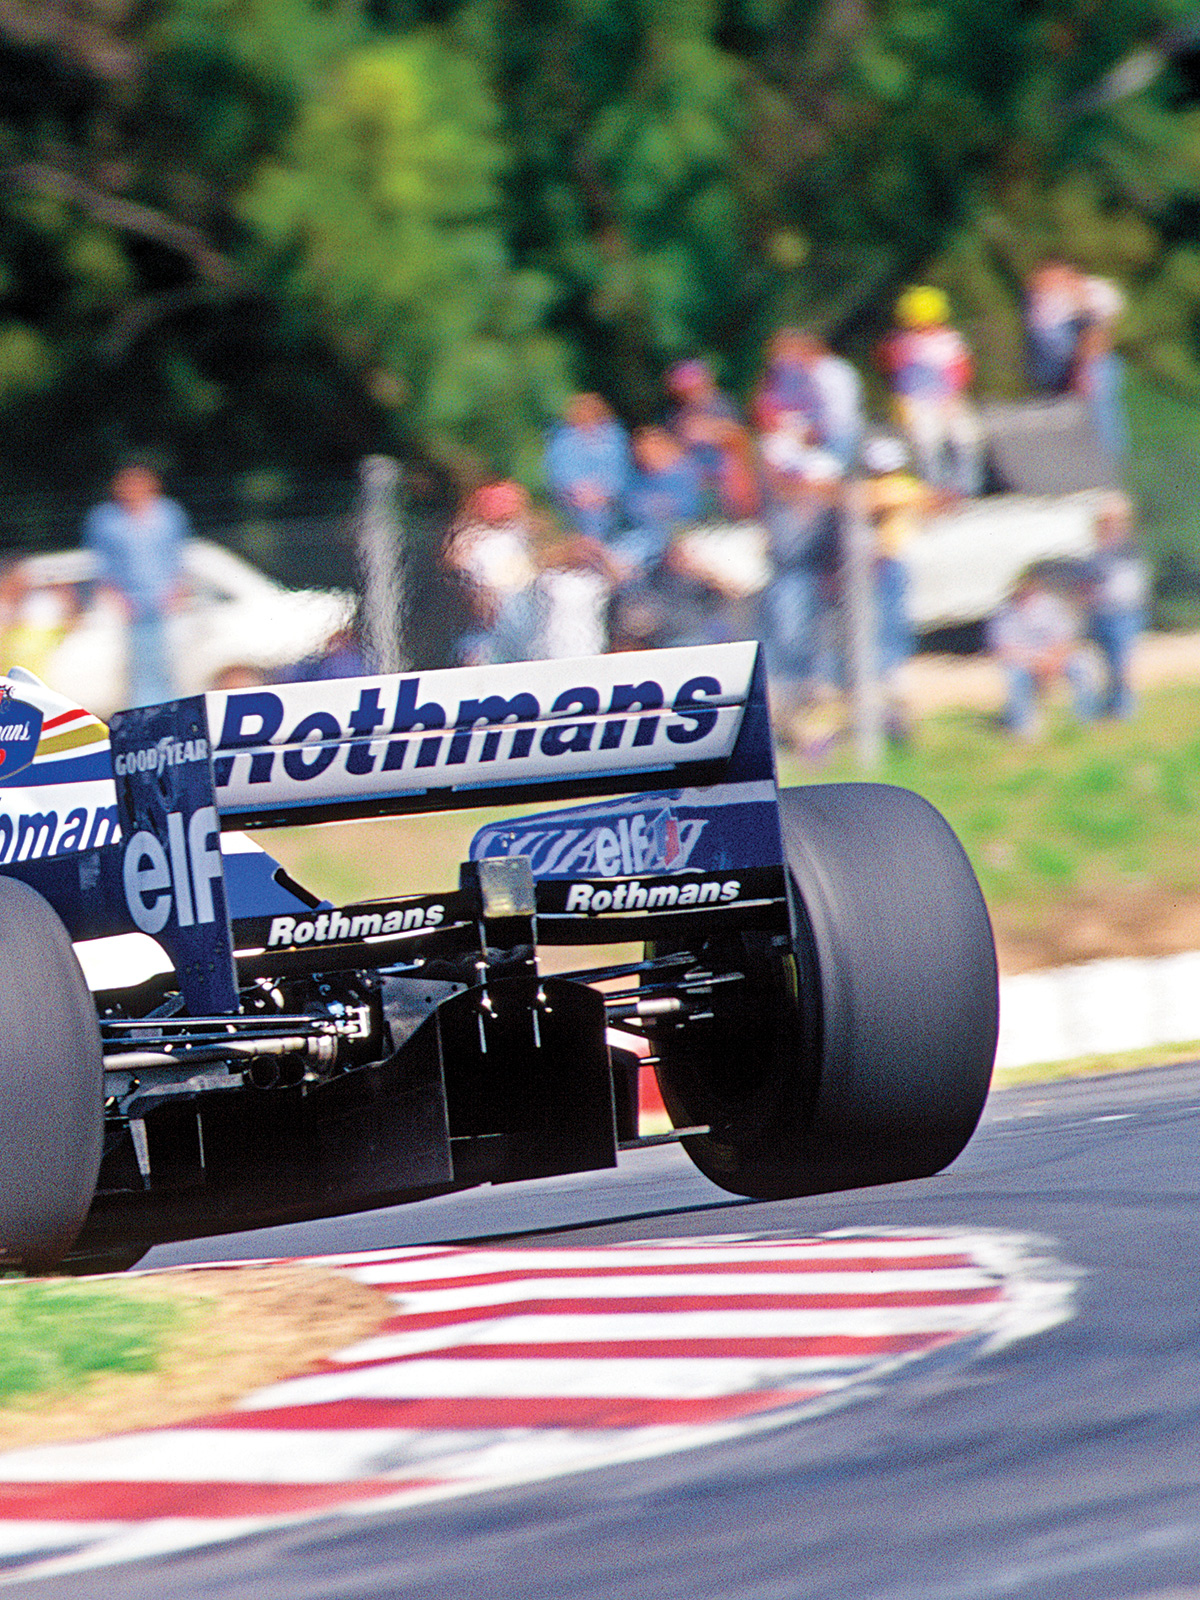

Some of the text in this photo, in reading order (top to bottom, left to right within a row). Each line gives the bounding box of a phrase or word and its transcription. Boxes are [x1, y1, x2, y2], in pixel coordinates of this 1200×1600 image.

[115, 736, 209, 777] GOODYEAR
[215, 676, 721, 787] Rothmans
[123, 806, 222, 934] elf
[596, 815, 650, 876] elf
[565, 881, 741, 912] Rothmans
[267, 904, 445, 946] Rothmans
